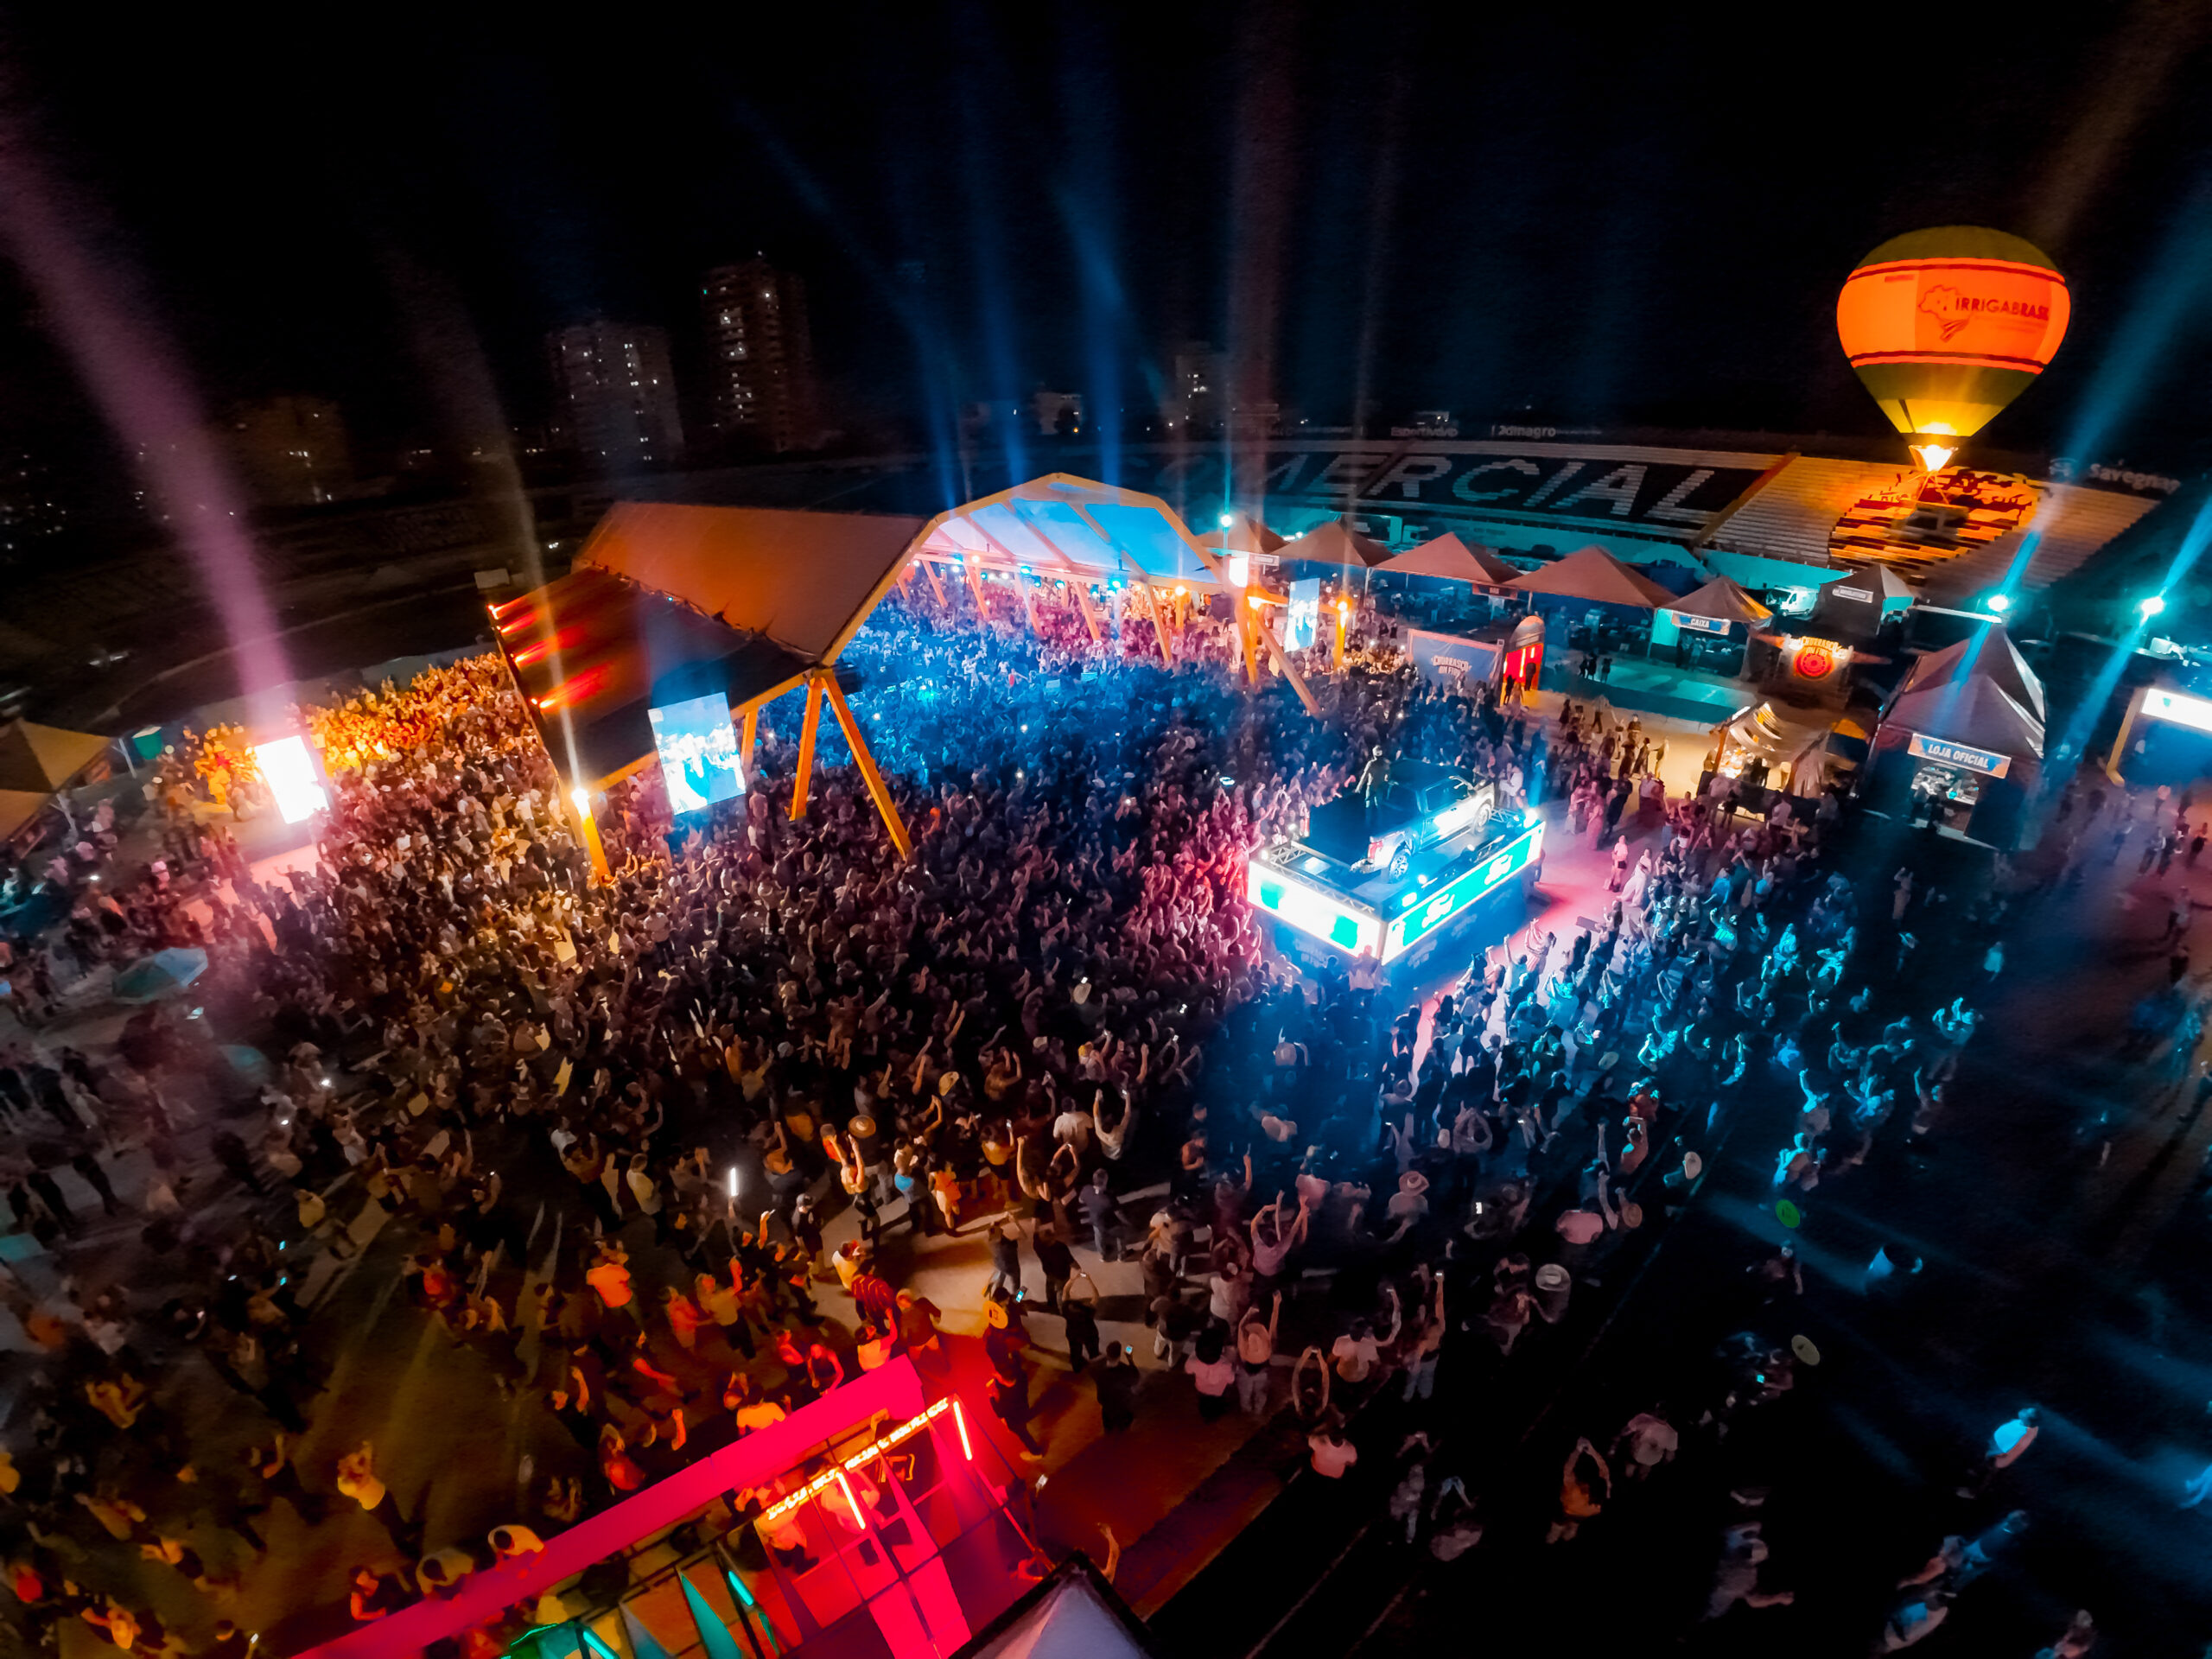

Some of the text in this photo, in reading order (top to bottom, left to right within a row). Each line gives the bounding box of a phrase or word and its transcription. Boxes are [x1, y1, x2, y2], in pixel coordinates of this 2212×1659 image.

[1690, 618, 1710, 628] CAIXA
[1928, 744, 1989, 768] LOJA OFICIAL
